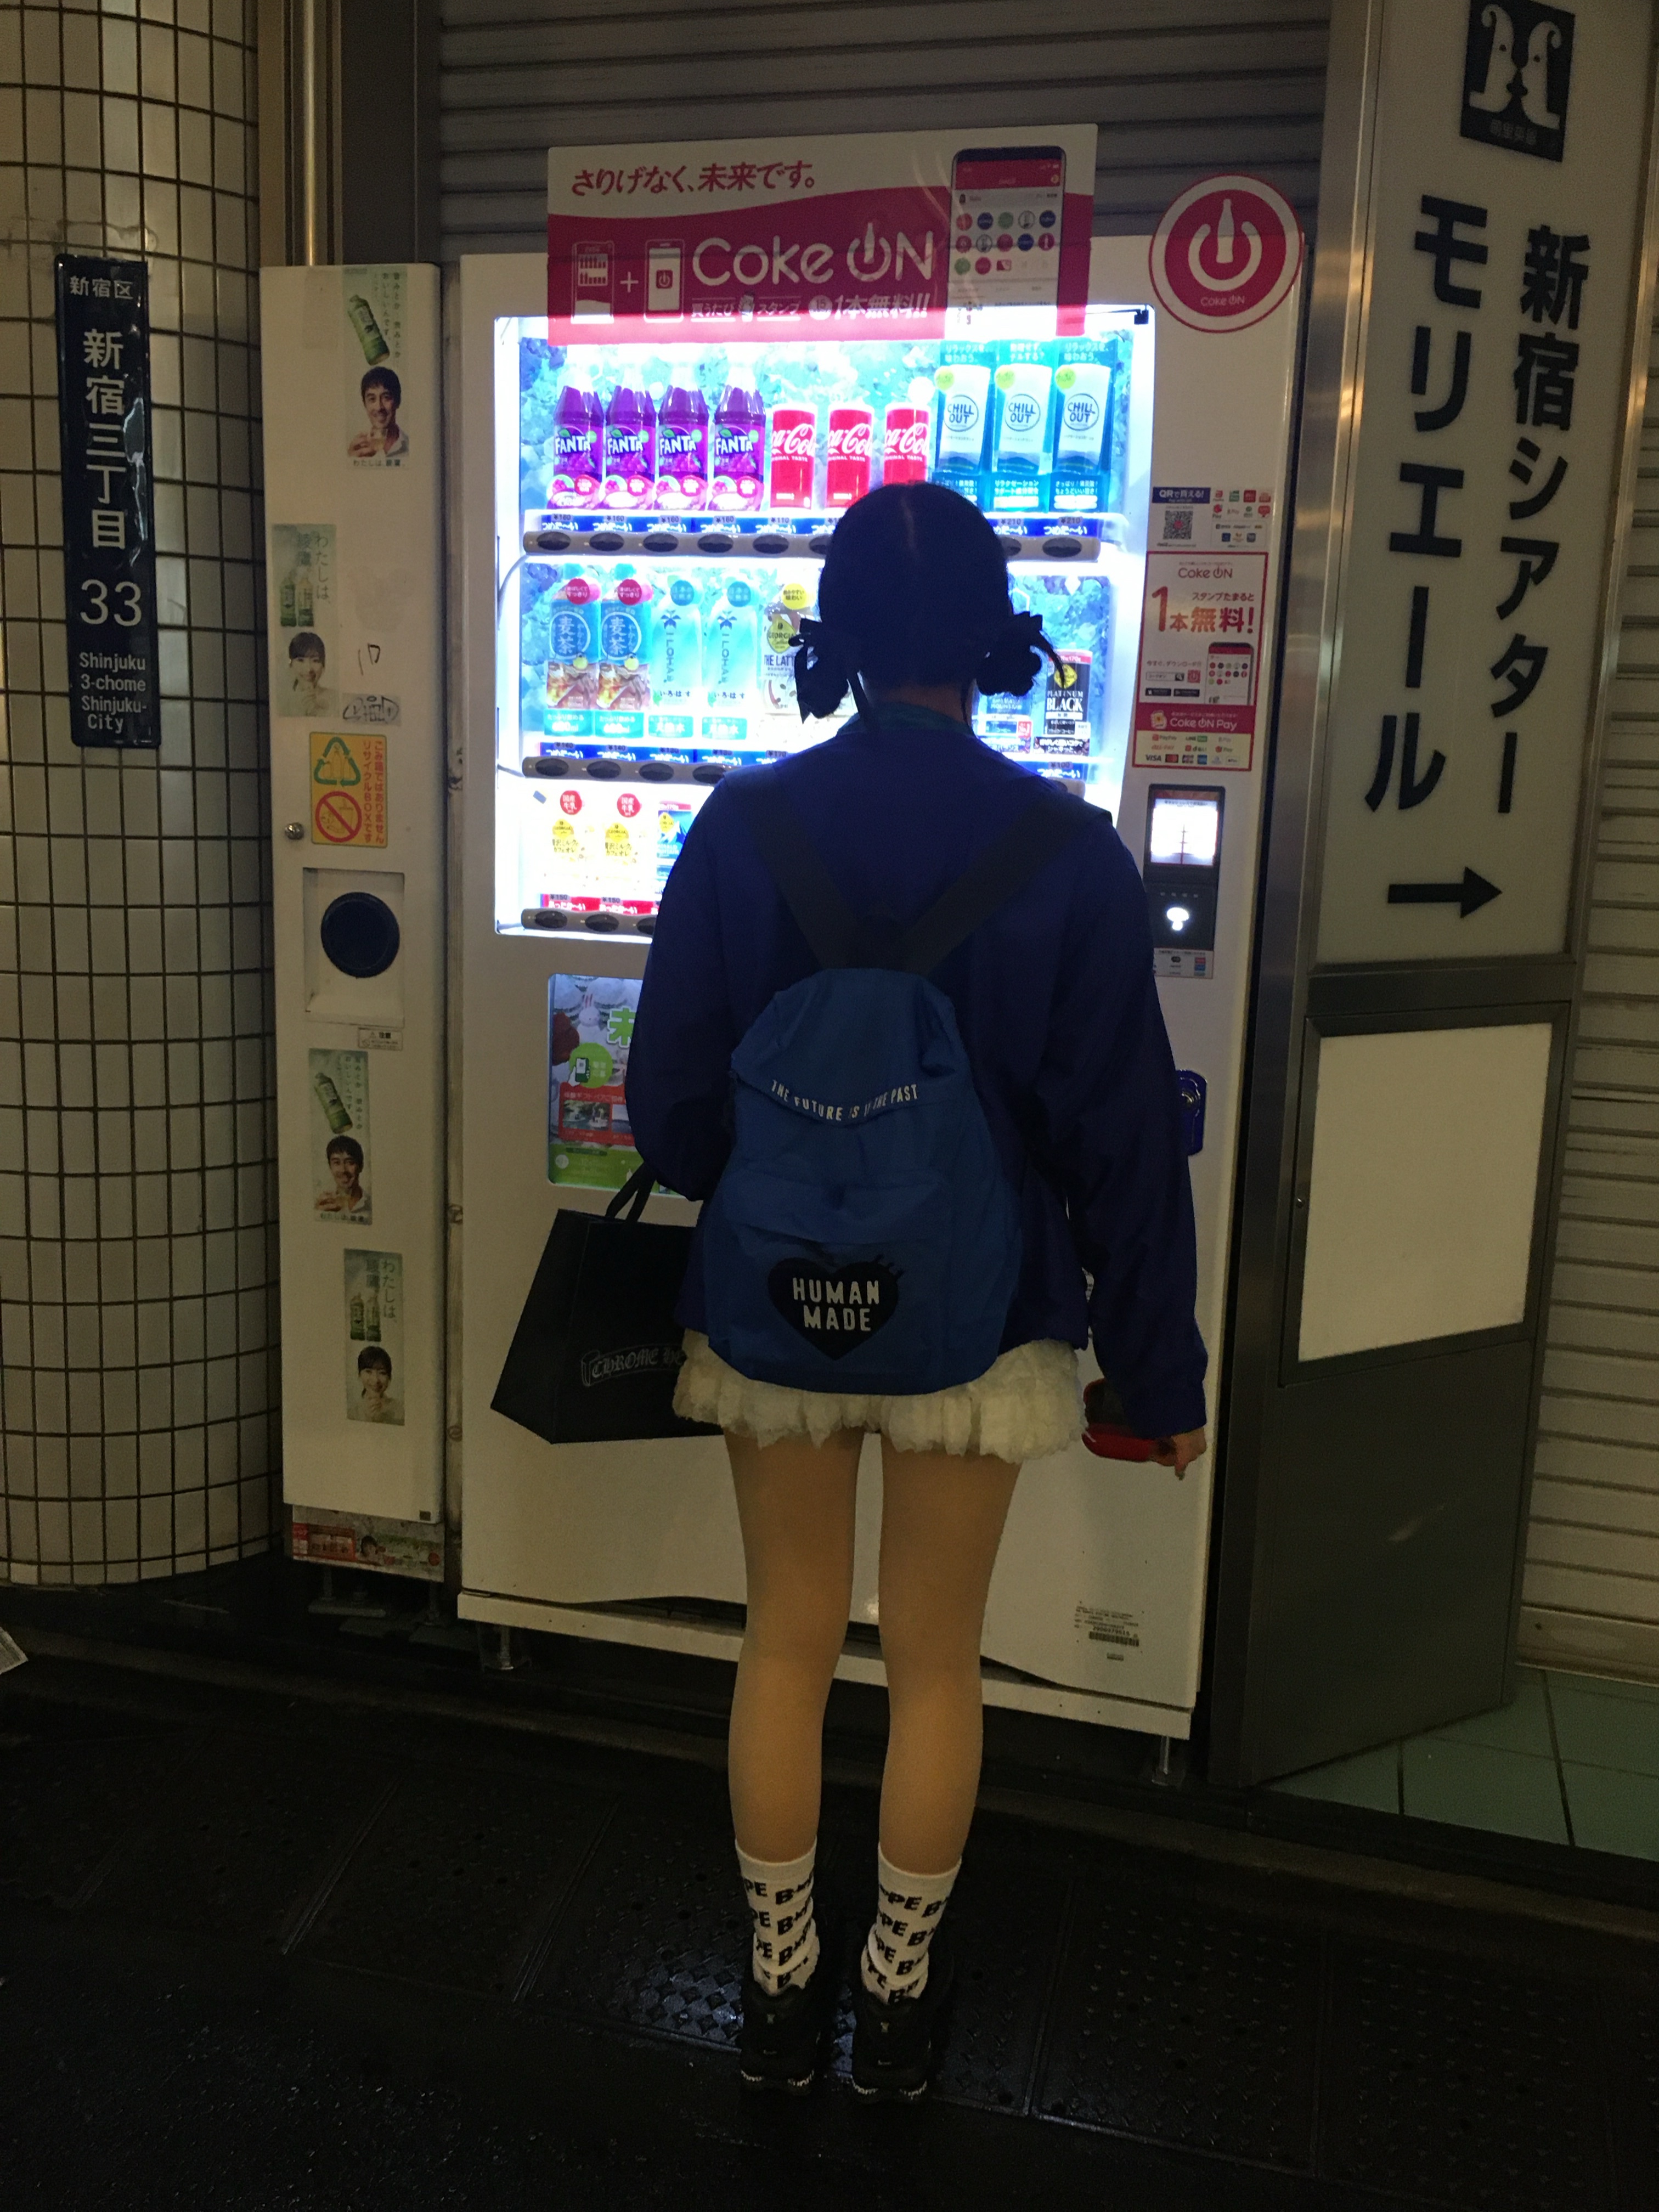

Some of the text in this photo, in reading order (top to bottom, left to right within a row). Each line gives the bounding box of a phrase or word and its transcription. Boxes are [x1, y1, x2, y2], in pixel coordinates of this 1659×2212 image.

[572, 160, 815, 195] さりげなく、未来です。
[692, 222, 933, 286] Coke ON
[70, 276, 133, 298] 新宿区
[1201, 296, 1226, 306] Coke
[947, 402, 974, 415] CHILL
[1008, 402, 1036, 415] CHILL
[1068, 402, 1096, 415] CHILL
[1070, 412, 1090, 423] OUT
[949, 413, 969, 425] OUT
[1010, 413, 1031, 424] OUT
[84, 331, 127, 550] 新宿三丁目
[555, 436, 591, 455] FANTA
[607, 436, 643, 455] FANTA
[659, 436, 696, 455] FANTA
[715, 436, 753, 455] FANTA
[1363, 194, 1488, 812] モリエール
[1489, 223, 1590, 816] 新宿シアター
[1178, 566, 1233, 579] Coke ON
[80, 579, 142, 627] 33
[1192, 592, 1255, 602] スタンプたまると
[1152, 585, 1255, 634] 1本無料!
[557, 616, 575, 654] 麦茶
[609, 616, 627, 655] 麦茶
[79, 652, 145, 672] Shinjuku
[81, 675, 146, 691] 3-chome
[82, 695, 147, 715] Shinjuku-
[1046, 697, 1084, 712] BLACK
[87, 713, 124, 733] City
[1170, 718, 1197, 728] Coke
[1216, 719, 1237, 732] Pay
[621, 797, 634, 805] 国産
[771, 1079, 790, 1103] THE
[794, 1096, 843, 1121] FUTURE
[890, 1084, 918, 1104] PAST
[792, 1277, 879, 1305] HUMAN
[803, 1305, 871, 1331] MADE
